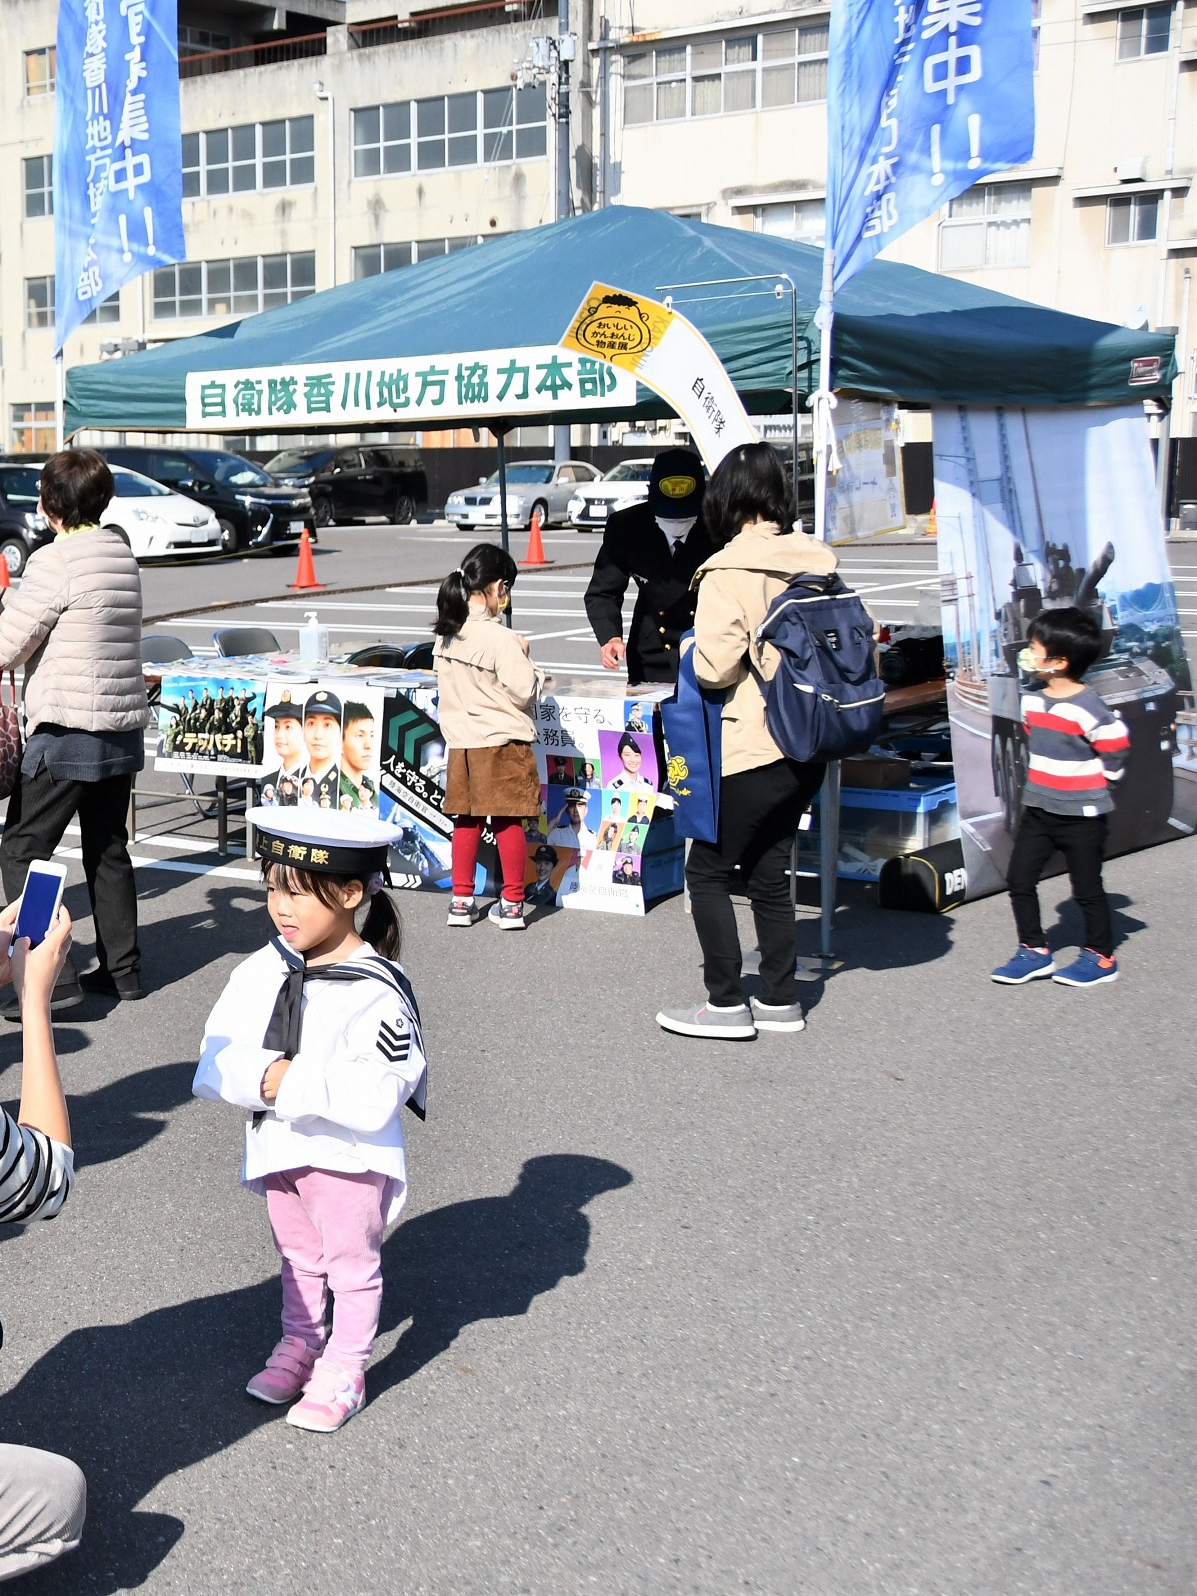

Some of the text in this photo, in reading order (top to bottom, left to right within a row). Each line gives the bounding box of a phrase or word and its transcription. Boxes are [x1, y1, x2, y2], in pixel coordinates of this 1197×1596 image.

[596, 321, 634, 331] おいしい
[590, 330, 636, 342] かんおんじ
[596, 340, 629, 352] 物産展
[200, 355, 618, 419] 自衛隊香川地方協力本部
[691, 376, 726, 439] 自衛隊
